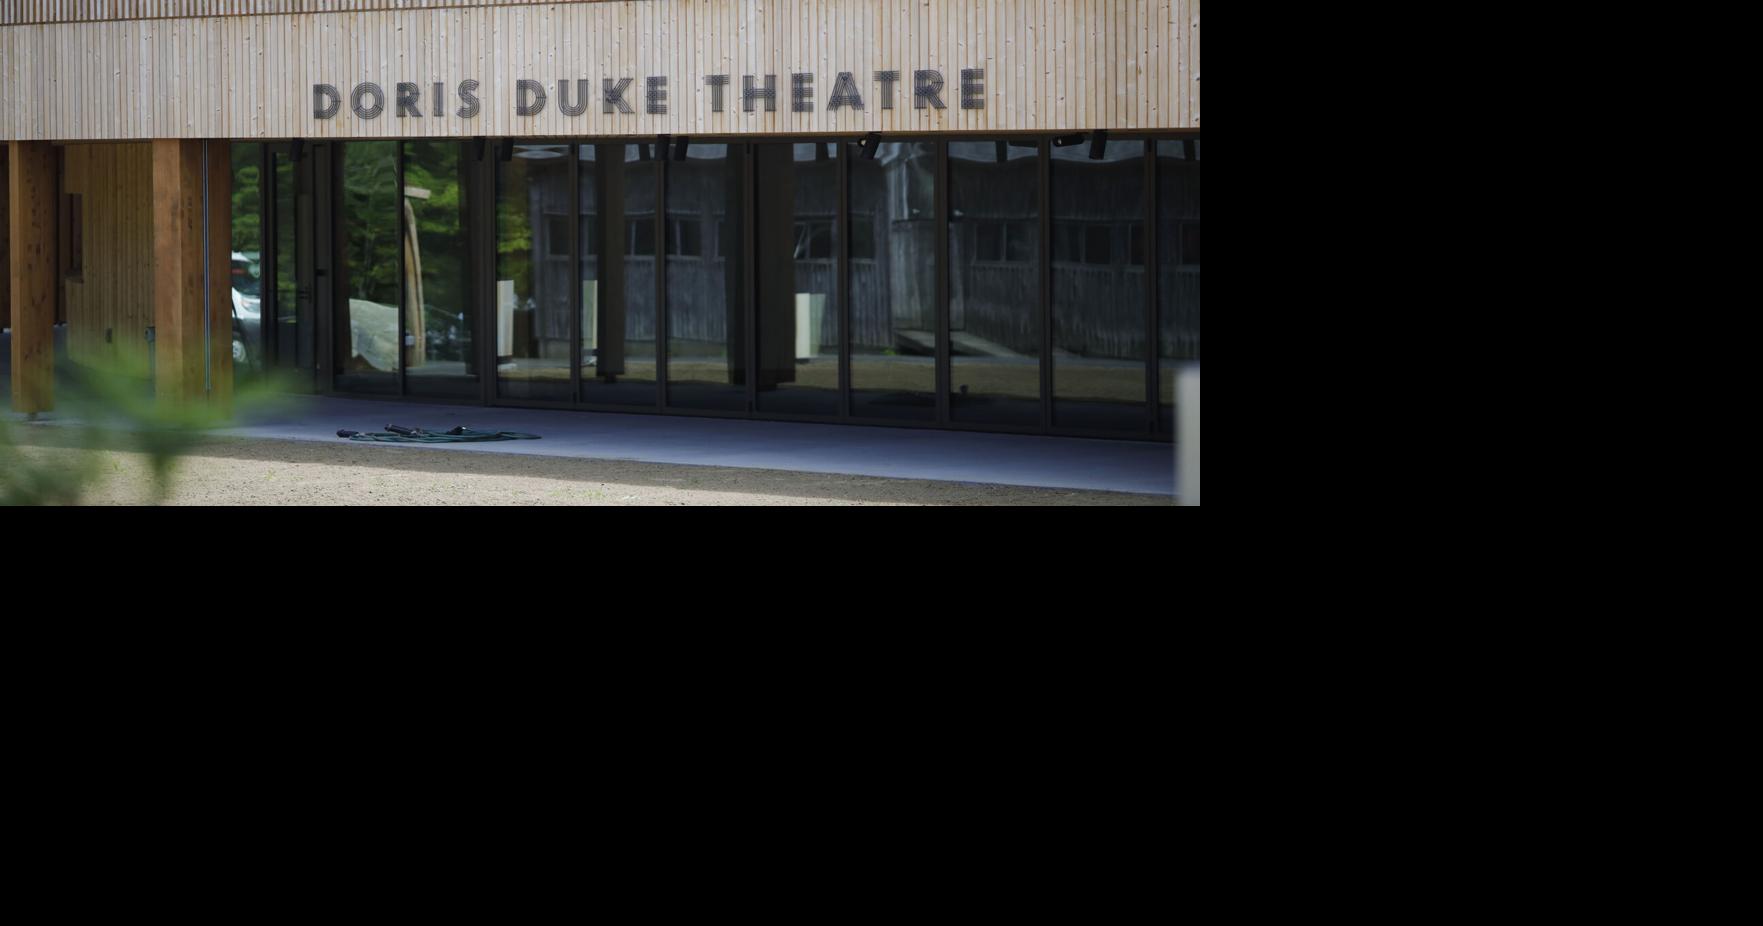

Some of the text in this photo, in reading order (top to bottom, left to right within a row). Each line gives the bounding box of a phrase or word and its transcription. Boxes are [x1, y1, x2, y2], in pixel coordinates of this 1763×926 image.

[313, 68, 985, 119] DORIS DUKE THEATRE
